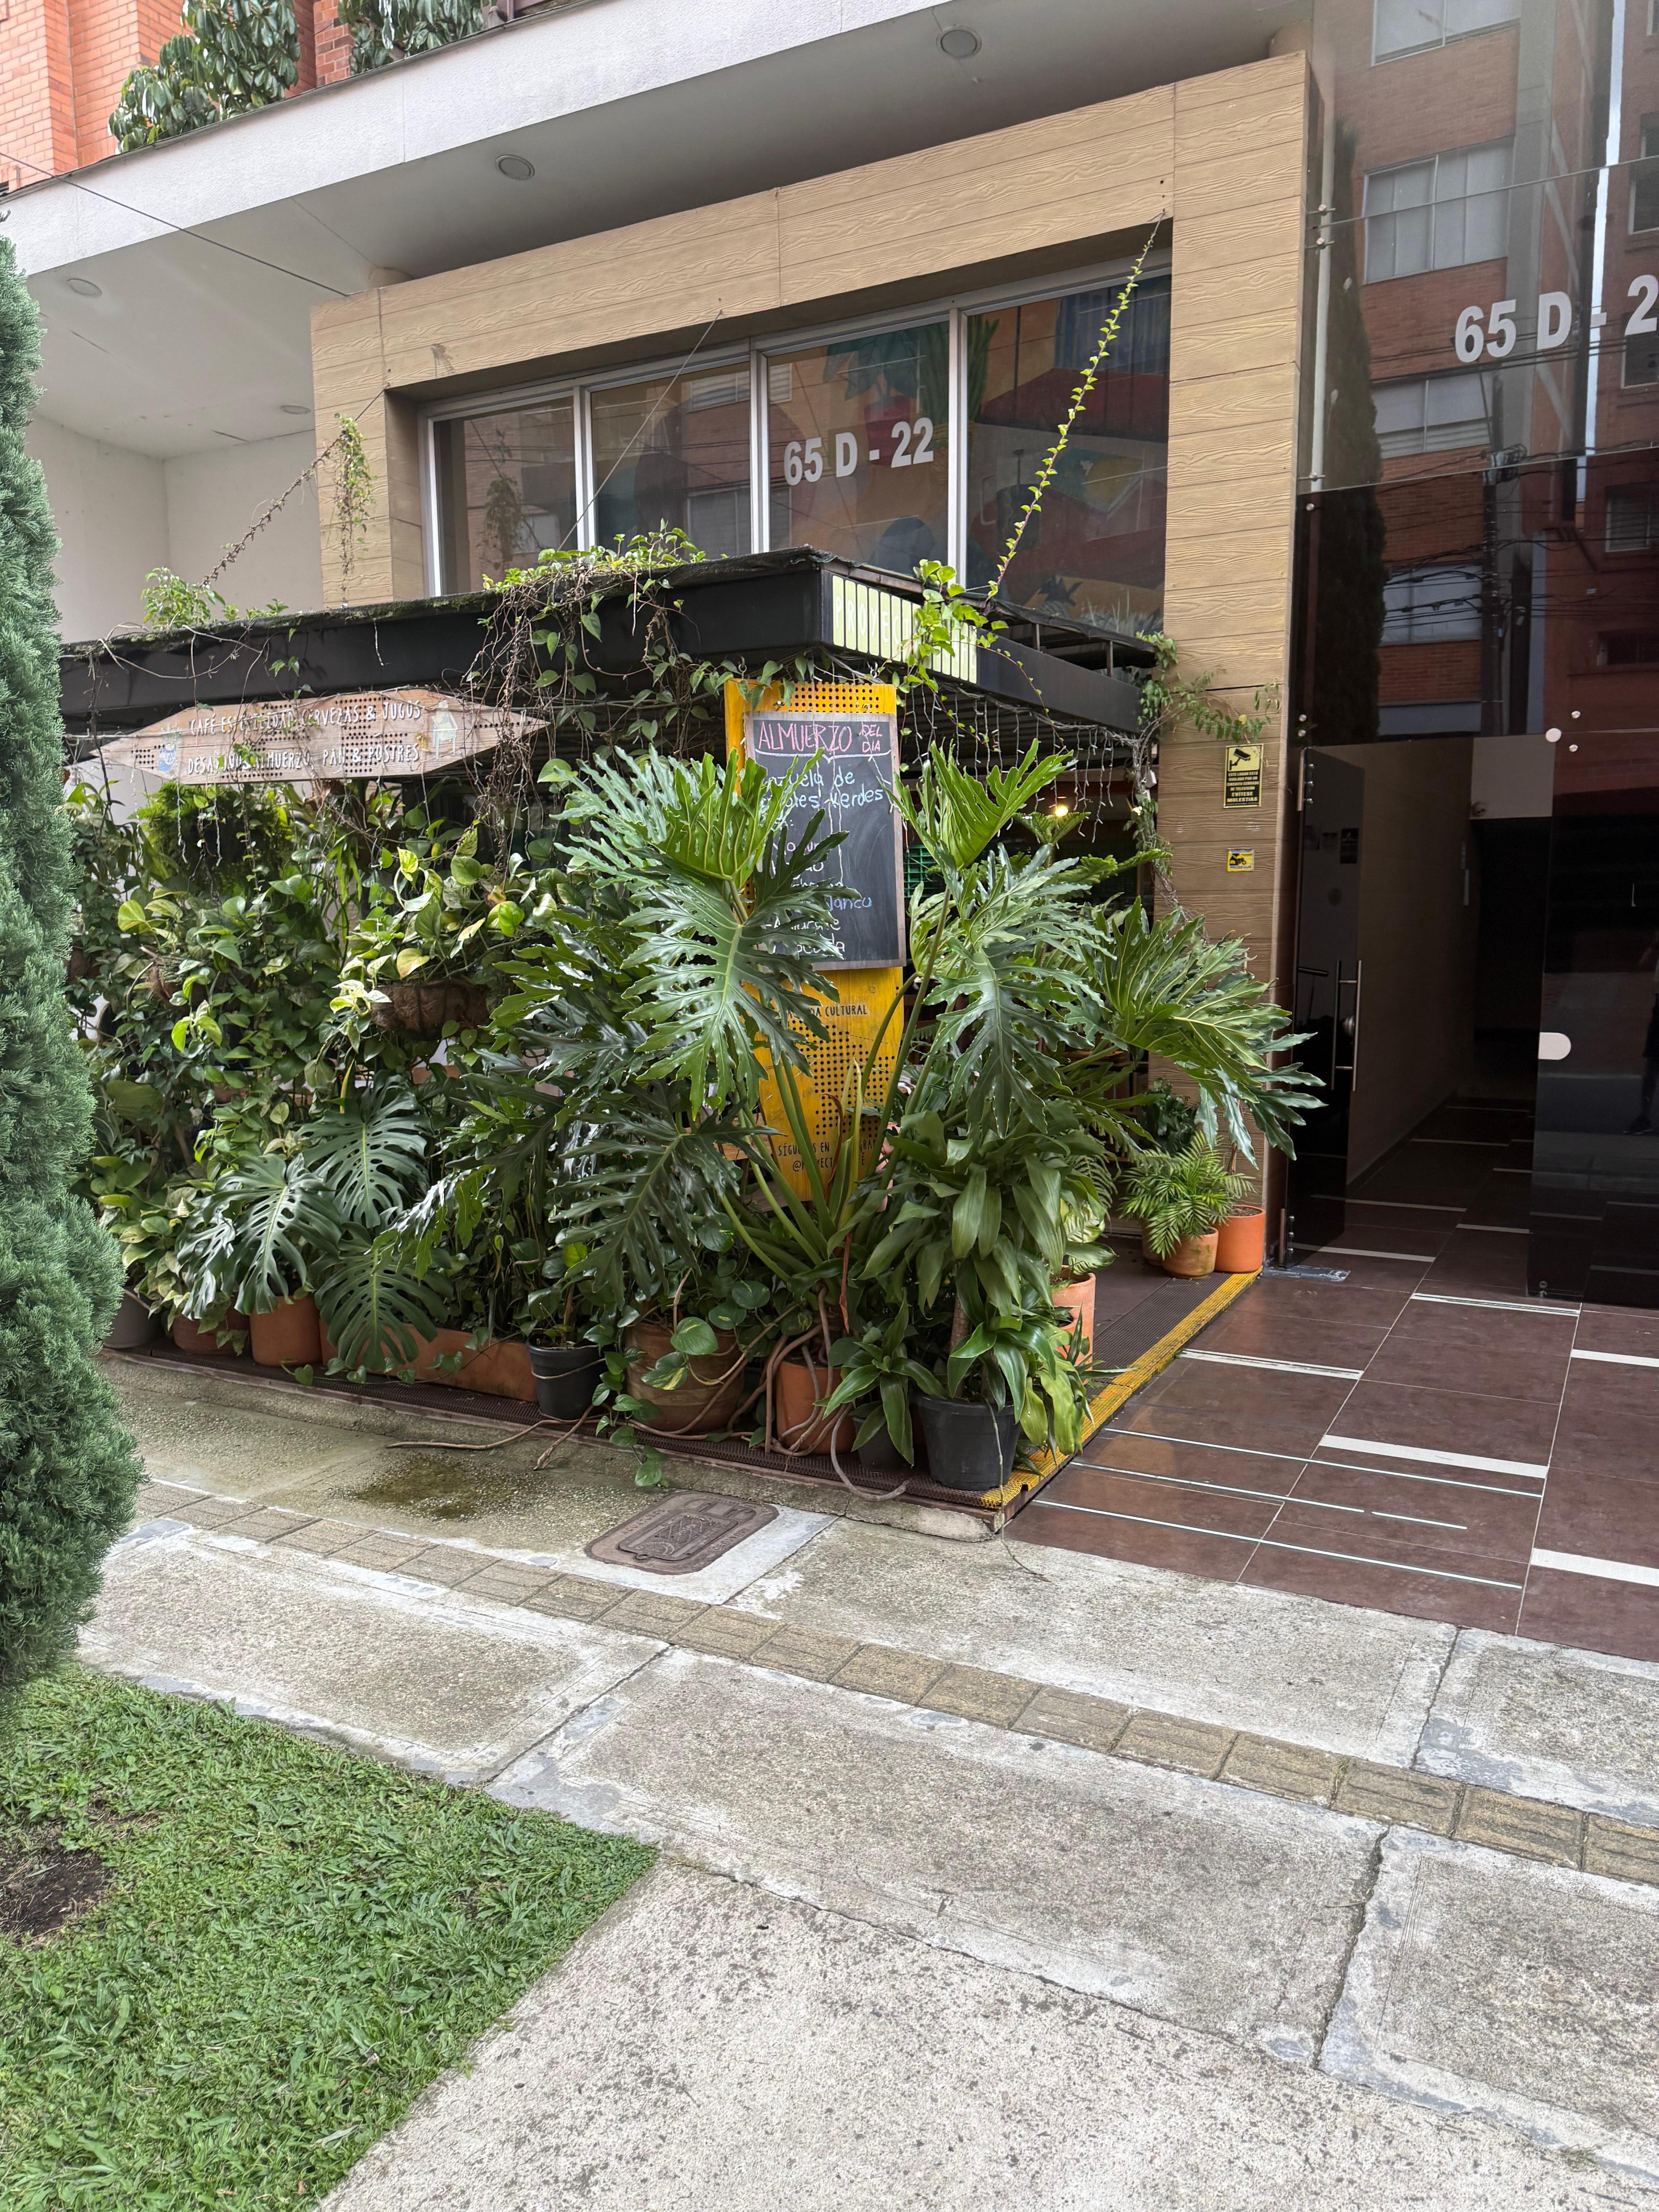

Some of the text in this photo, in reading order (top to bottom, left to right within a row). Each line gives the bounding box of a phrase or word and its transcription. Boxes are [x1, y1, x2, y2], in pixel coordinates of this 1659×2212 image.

[1455, 299, 1517, 363] 65
[1536, 291, 1572, 351] D
[1590, 312, 1607, 327] -
[783, 417, 934, 486] 65 D - 22
[835, 595, 913, 645] PROYECT
[190, 713, 216, 735] CAFÉ
[366, 705, 376, 720] &
[383, 700, 421, 720] JUGOS
[758, 721, 882, 752] ALMUERZO DEL
[862, 740, 881, 753] DIA
[323, 746, 346, 766] PAN
[352, 748, 362, 763] &
[368, 742, 419, 763] POSTRES
[834, 765, 855, 787] de
[830, 783, 884, 809] verdes
[825, 1005, 867, 1017] CULTURAL
[821, 1142, 830, 1152] EN
